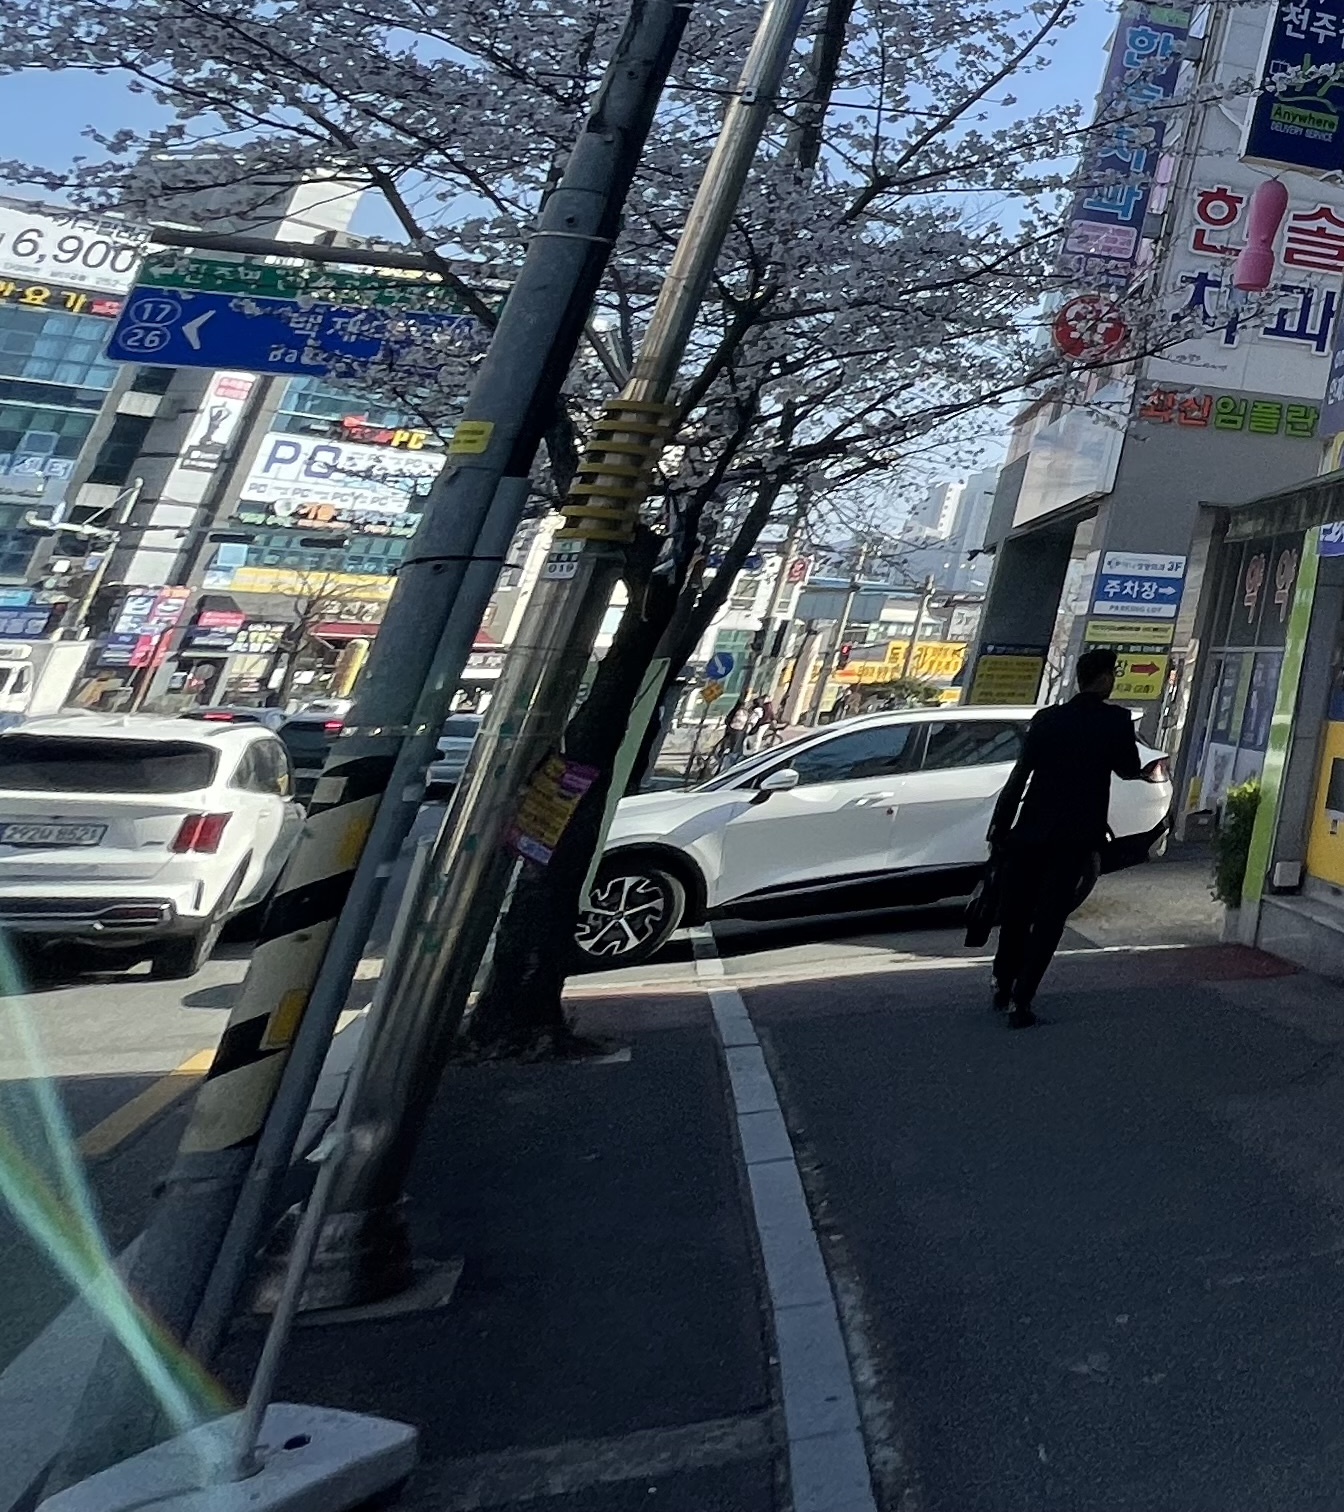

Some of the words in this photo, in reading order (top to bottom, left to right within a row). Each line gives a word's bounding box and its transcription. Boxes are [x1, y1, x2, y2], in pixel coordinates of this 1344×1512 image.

[1273, 105, 1337, 131] Anywhere
[139, 303, 173, 323] 17
[126, 328, 162, 348] 26
[1103, 579, 1158, 600] 주차장
